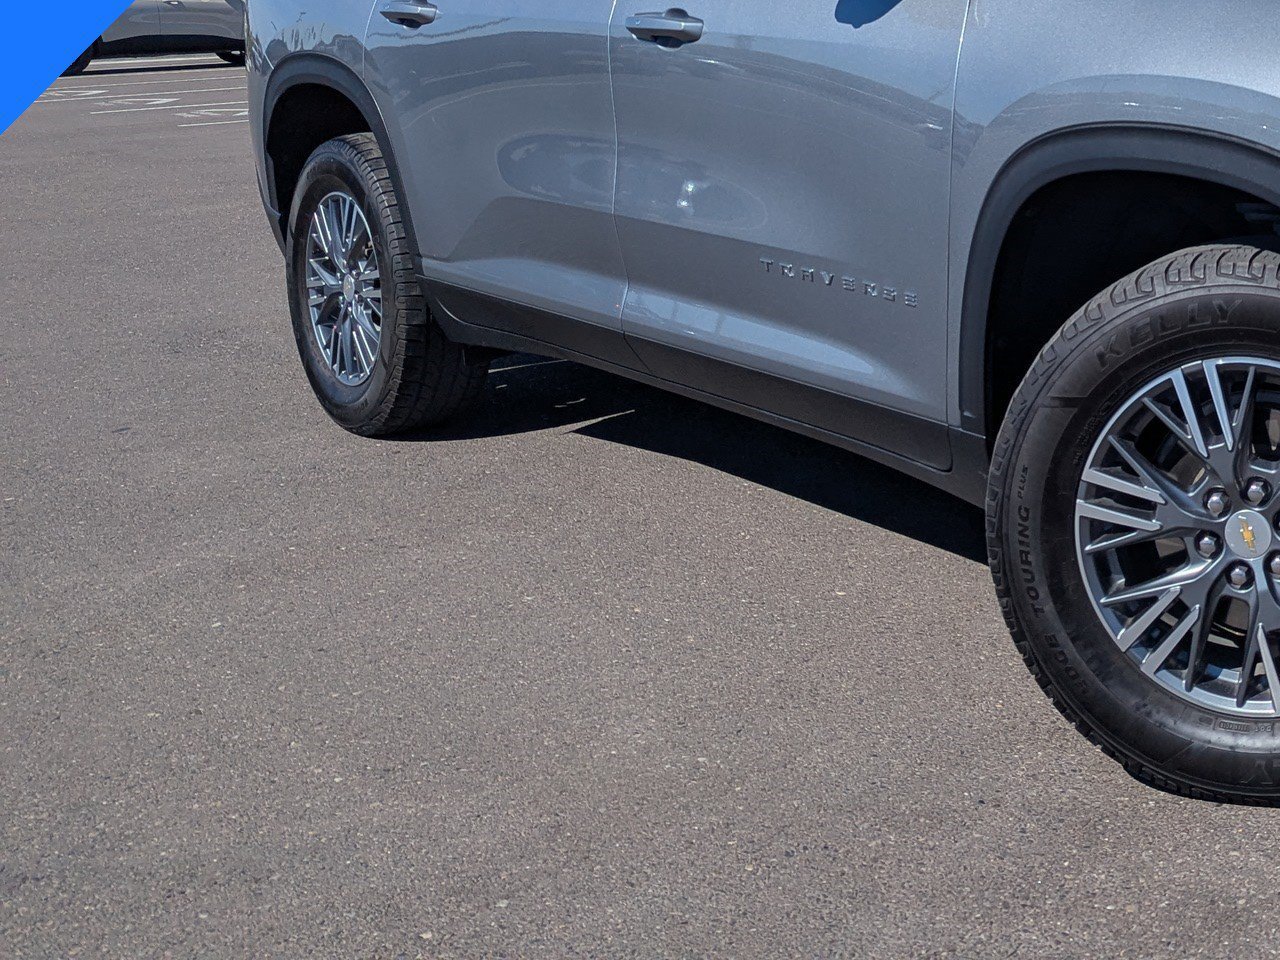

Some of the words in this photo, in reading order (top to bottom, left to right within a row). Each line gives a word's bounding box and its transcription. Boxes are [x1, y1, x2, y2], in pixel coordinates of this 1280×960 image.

[760, 256, 918, 308] TRAVERSE
[1096, 298, 1244, 371] KELLY
[1016, 464, 1029, 500] PLUS
[1017, 504, 1046, 619] TOURING
